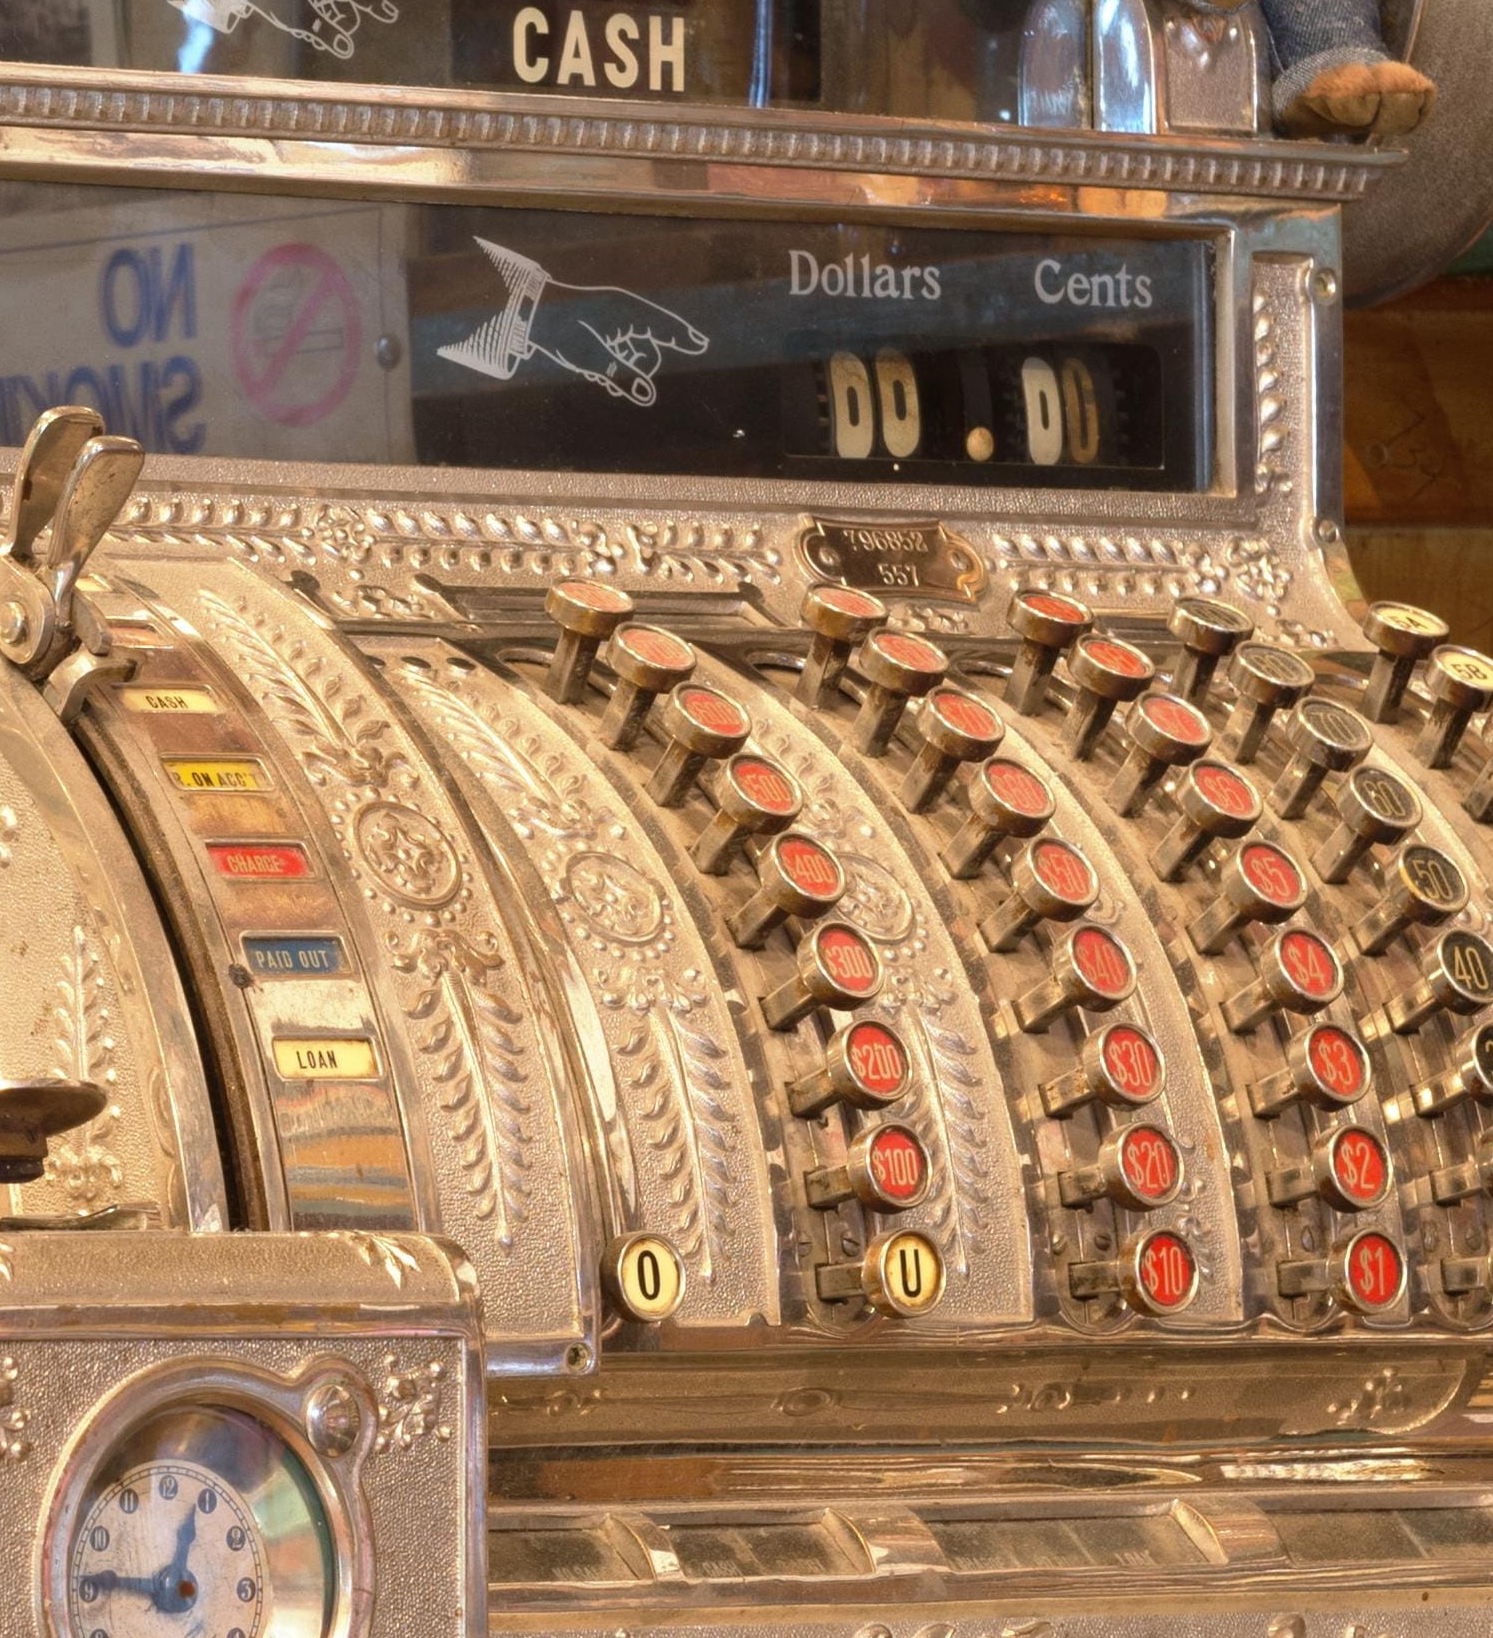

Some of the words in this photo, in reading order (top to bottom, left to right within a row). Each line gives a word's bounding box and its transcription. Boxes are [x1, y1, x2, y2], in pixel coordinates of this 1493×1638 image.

[512, 5, 686, 93] CASH
[787, 249, 943, 300] Dollars
[1033, 257, 1154, 309] Cents
[1453, 662, 1489, 681] 5B
[145, 694, 188, 710] CASH
[192, 771, 213, 787] ON
[227, 854, 282, 874] CHARGE
[1253, 854, 1291, 896] $5
[1415, 859, 1452, 900] 50
[255, 950, 293, 969] PAID
[298, 950, 330, 969] OUT
[1287, 944, 1326, 988] $4
[1453, 945, 1490, 990] 40
[296, 1049, 339, 1069] LOAN
[851, 1045, 902, 1081] $200
[1108, 1039, 1153, 1086] $30
[1318, 1038, 1355, 1089] $3
[872, 1148, 919, 1186] $100
[1127, 1141, 1173, 1189] $20
[1340, 1140, 1376, 1190] $2
[899, 1249, 922, 1299] U
[1144, 1246, 1184, 1296] $10
[1359, 1246, 1386, 1300] $1
